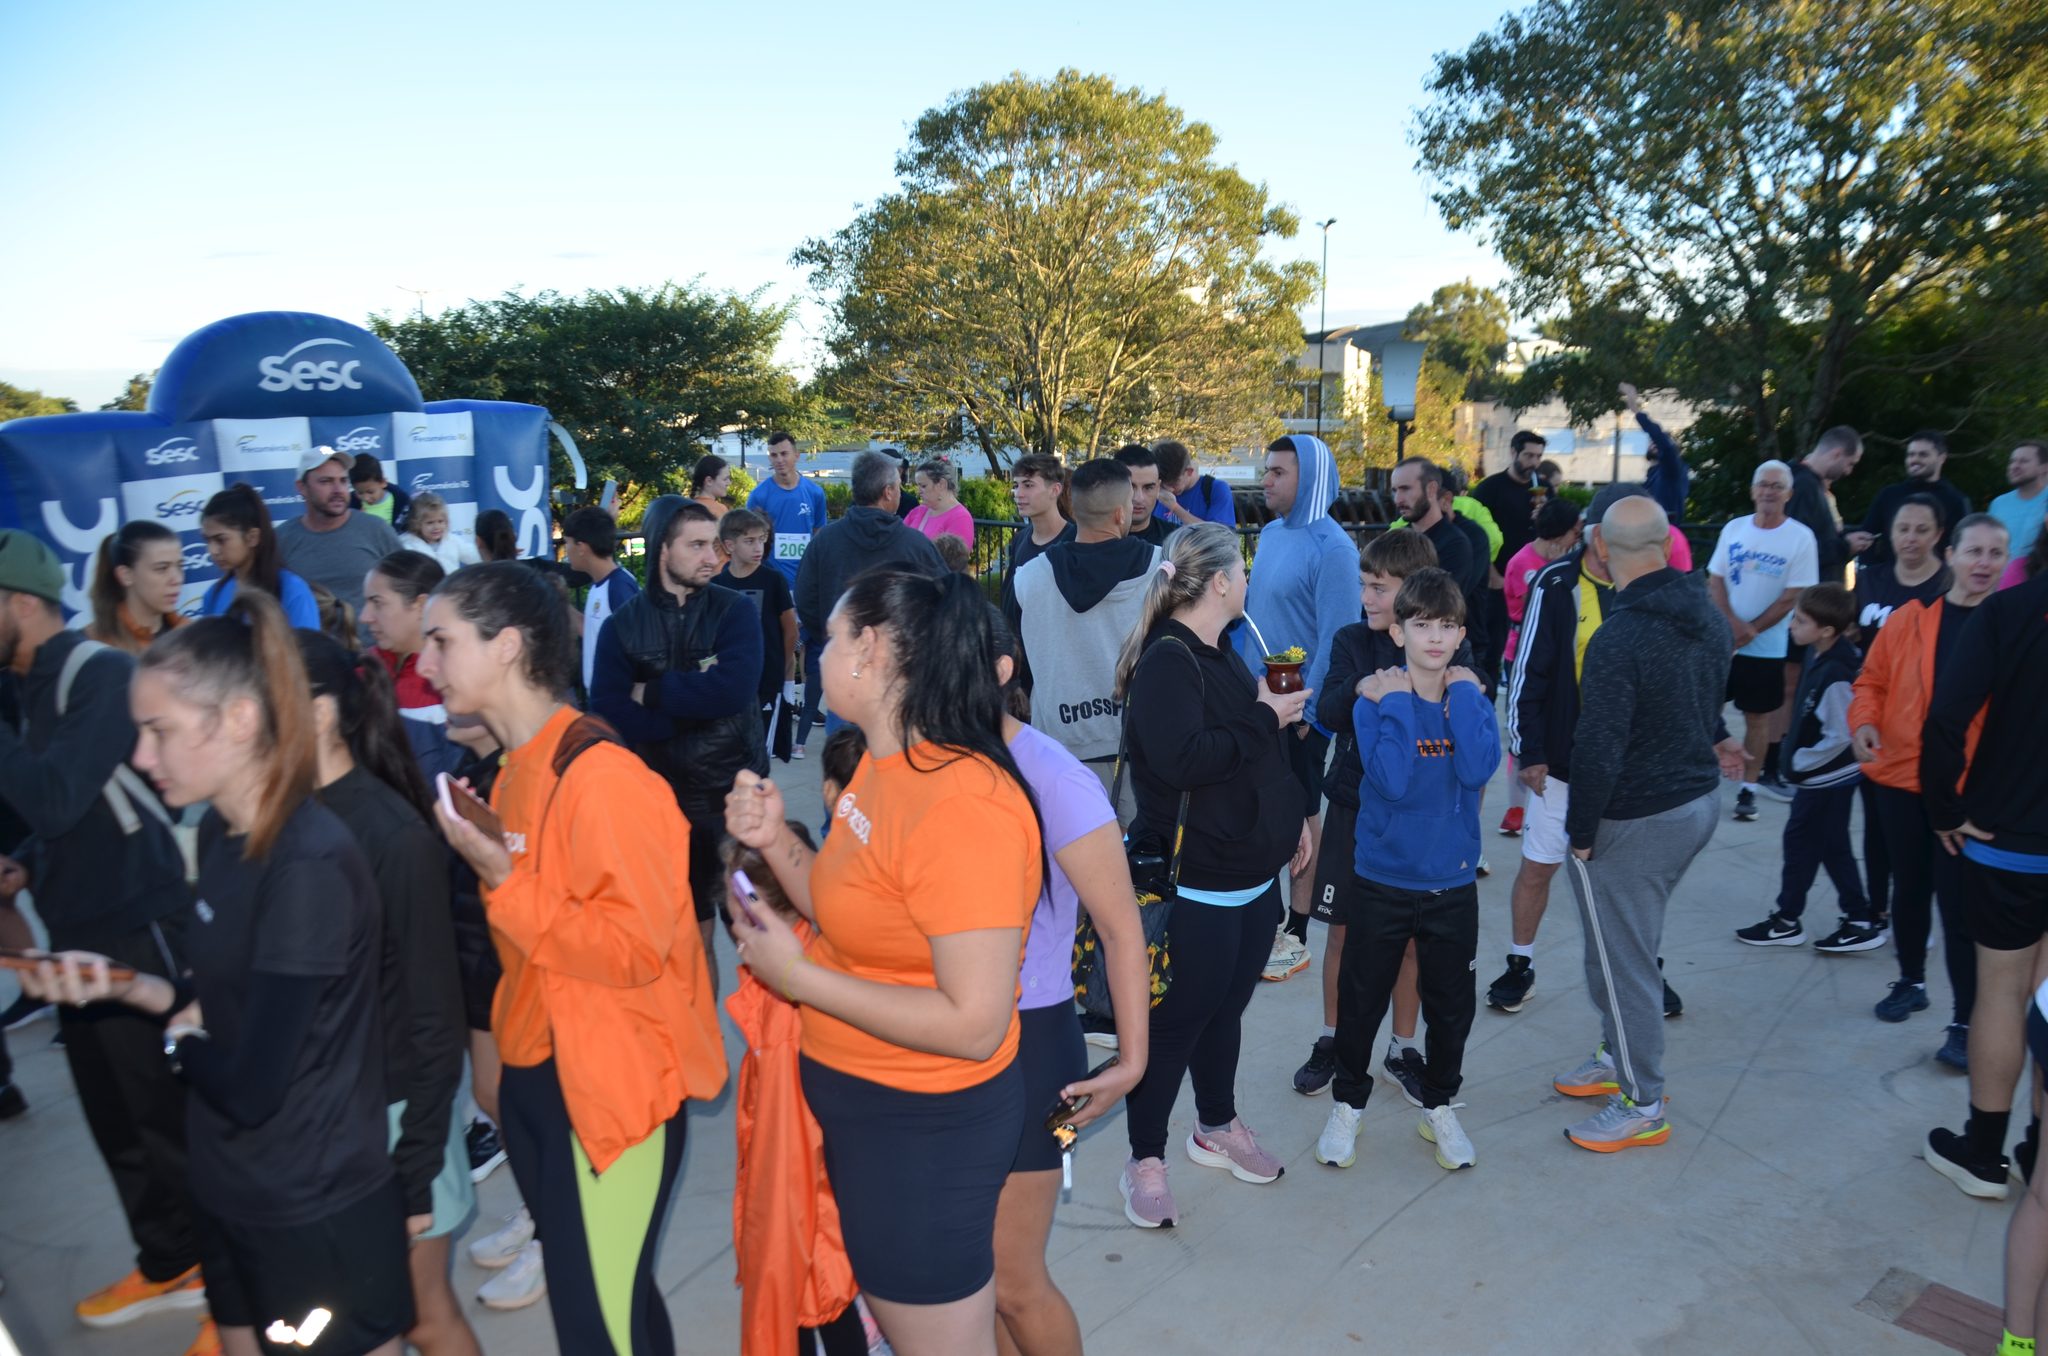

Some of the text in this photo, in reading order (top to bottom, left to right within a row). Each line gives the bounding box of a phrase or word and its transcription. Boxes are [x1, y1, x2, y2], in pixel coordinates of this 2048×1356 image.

[182, 544, 214, 570] esc
[780, 543, 805, 557] 206
[1859, 603, 1893, 628] M
[1323, 884, 1335, 904] 8
[1207, 1140, 1228, 1156] FILA
